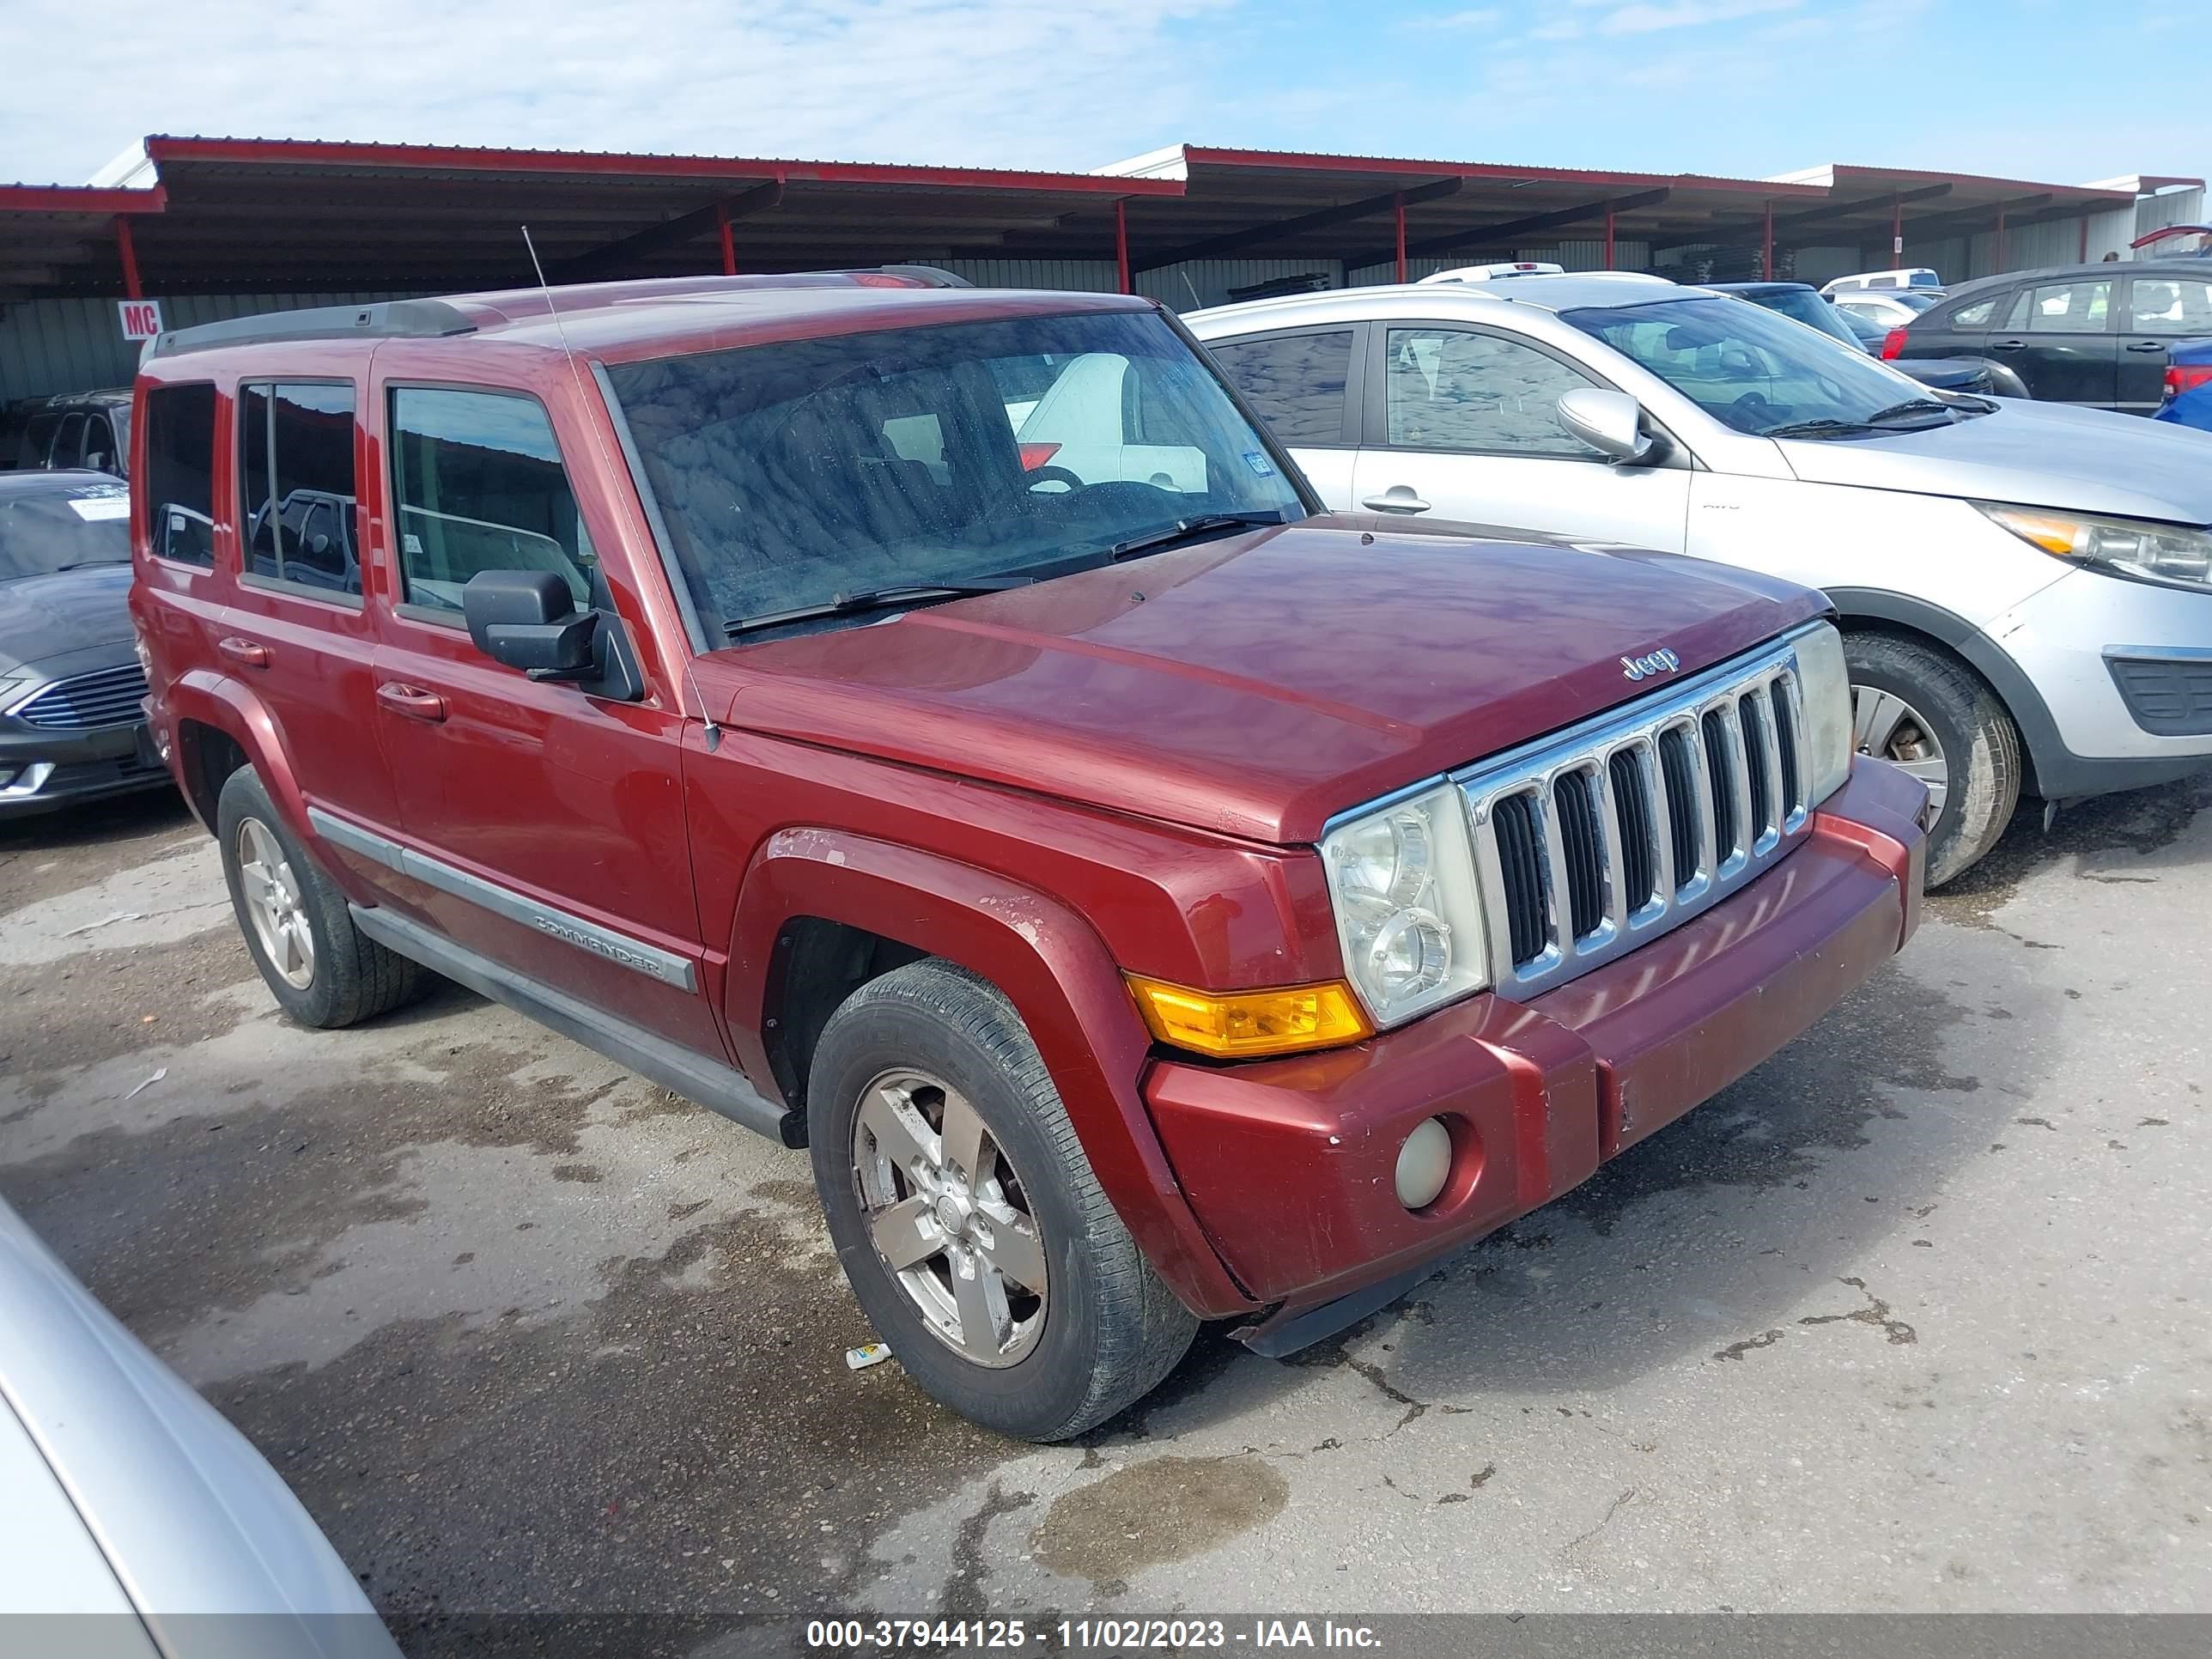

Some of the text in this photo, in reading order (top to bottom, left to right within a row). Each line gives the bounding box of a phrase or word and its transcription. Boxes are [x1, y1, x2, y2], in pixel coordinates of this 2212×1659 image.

[124, 305, 158, 335] MC
[1620, 647, 1680, 681] Jeep
[534, 915, 662, 976] COMMANDER
